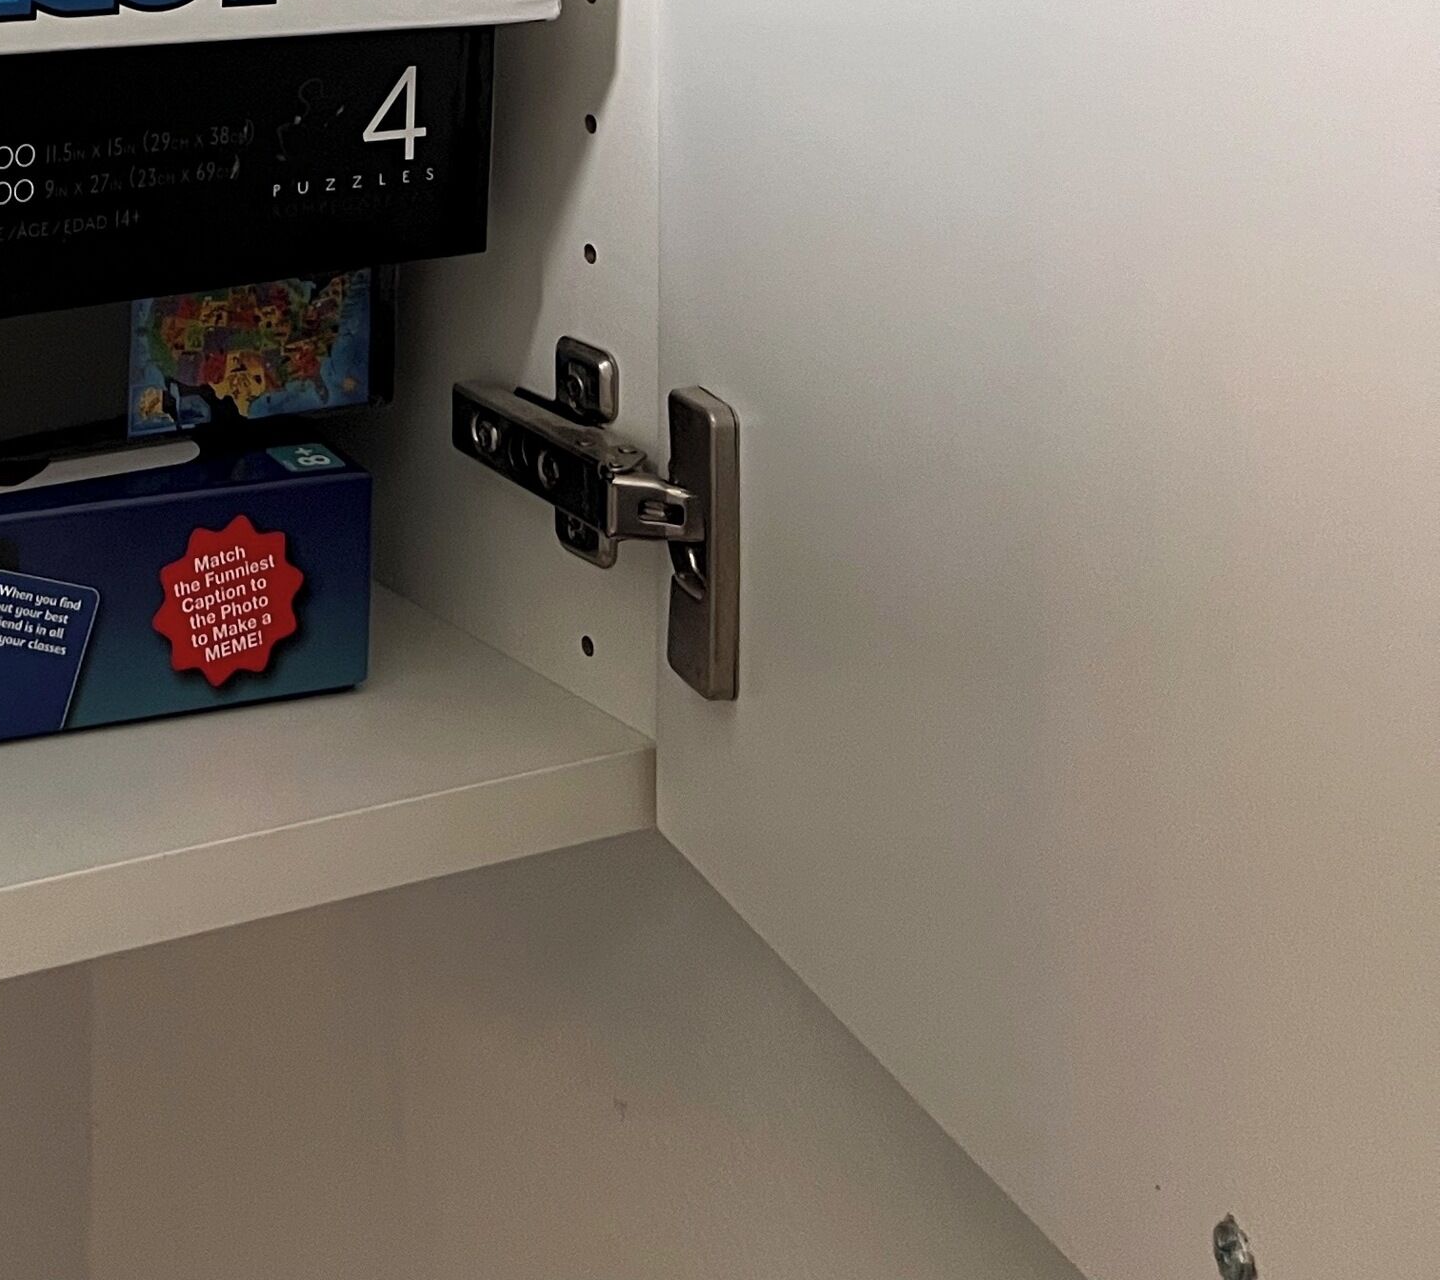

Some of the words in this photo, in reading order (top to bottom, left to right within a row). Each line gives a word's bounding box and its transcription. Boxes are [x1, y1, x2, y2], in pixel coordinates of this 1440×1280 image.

[362, 65, 427, 160] 4
[272, 167, 435, 198] PUZZLES
[193, 545, 246, 574] Match
[173, 580, 201, 598] the
[204, 554, 275, 588] Funniest
[0, 583, 33, 602] When
[34, 594, 58, 607] you
[59, 596, 82, 611] find
[181, 583, 247, 613] Caption
[250, 577, 267, 592] to
[15, 606, 43, 619] your
[44, 609, 69, 625] best
[189, 611, 216, 630] the
[220, 595, 269, 620] Photo
[24, 620, 34, 634] is
[35, 622, 47, 636] in
[49, 627, 65, 640] all
[191, 633, 208, 648] to
[212, 617, 257, 642] Make
[261, 612, 272, 626] a
[204, 629, 264, 663] MEME!
[27, 639, 67, 656] classes
